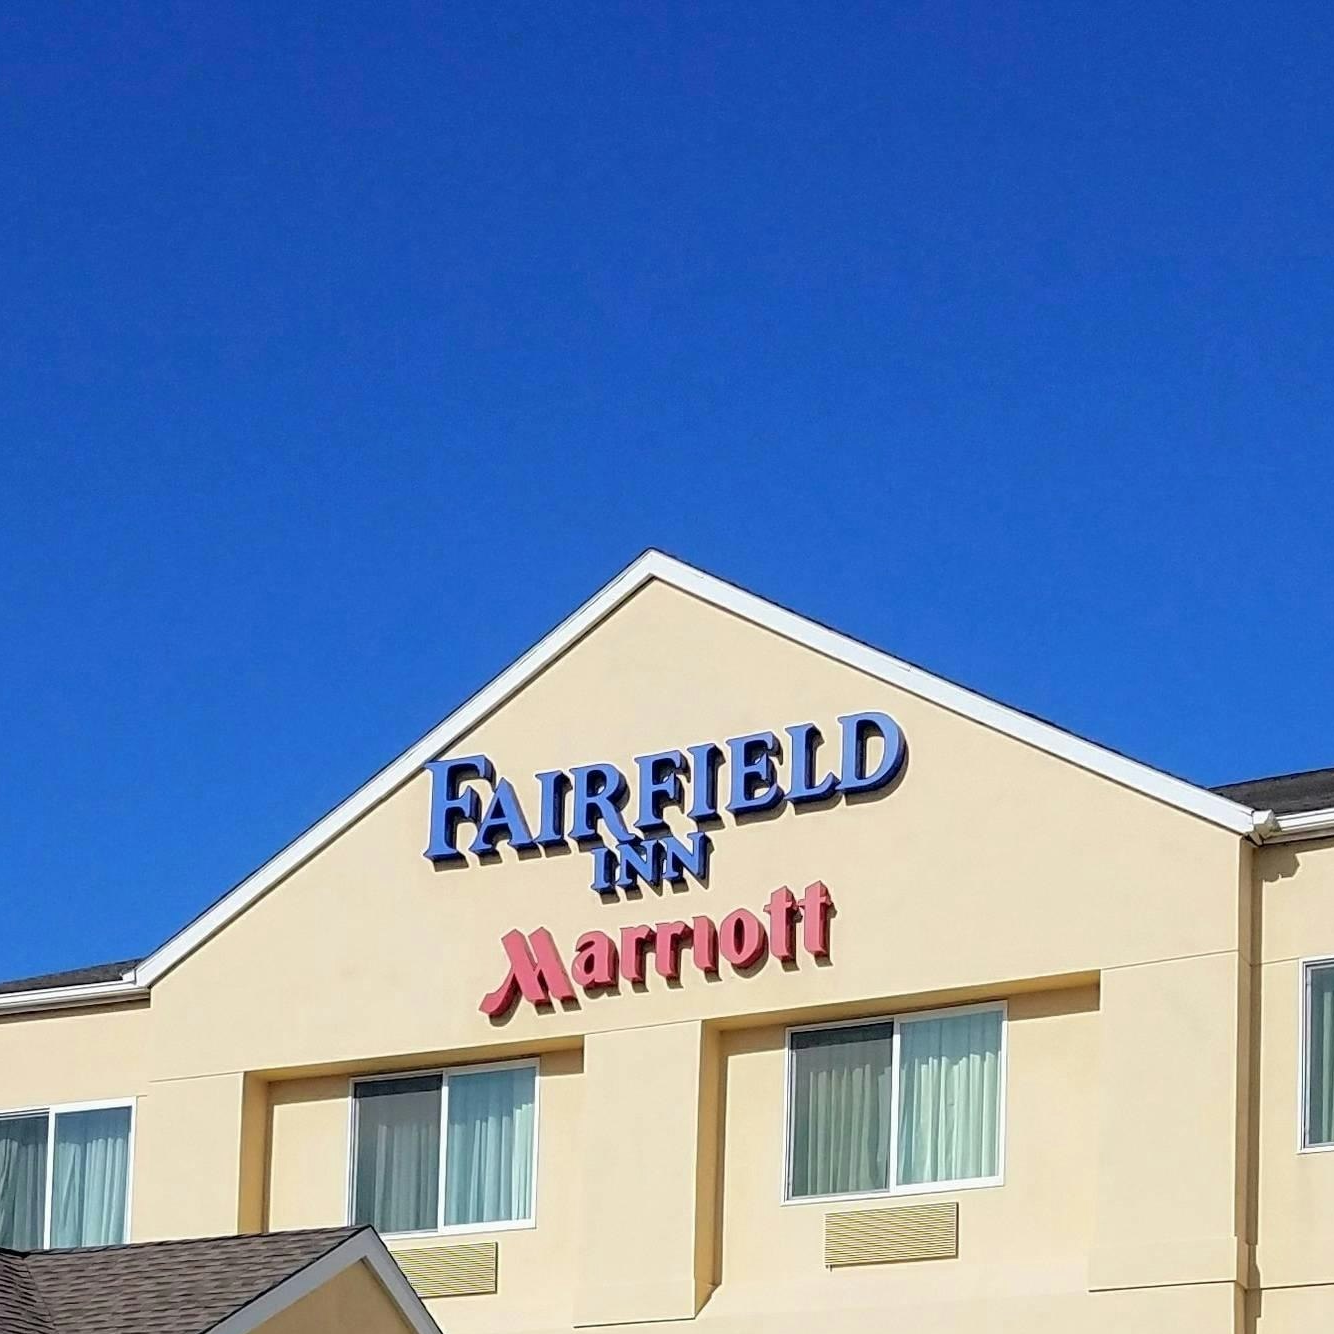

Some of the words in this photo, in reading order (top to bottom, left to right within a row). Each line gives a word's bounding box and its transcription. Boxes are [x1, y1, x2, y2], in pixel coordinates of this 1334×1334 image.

[423, 711, 909, 864] FAIRFIELD
[590, 832, 713, 895] INN
[479, 880, 836, 1020] Marriott
